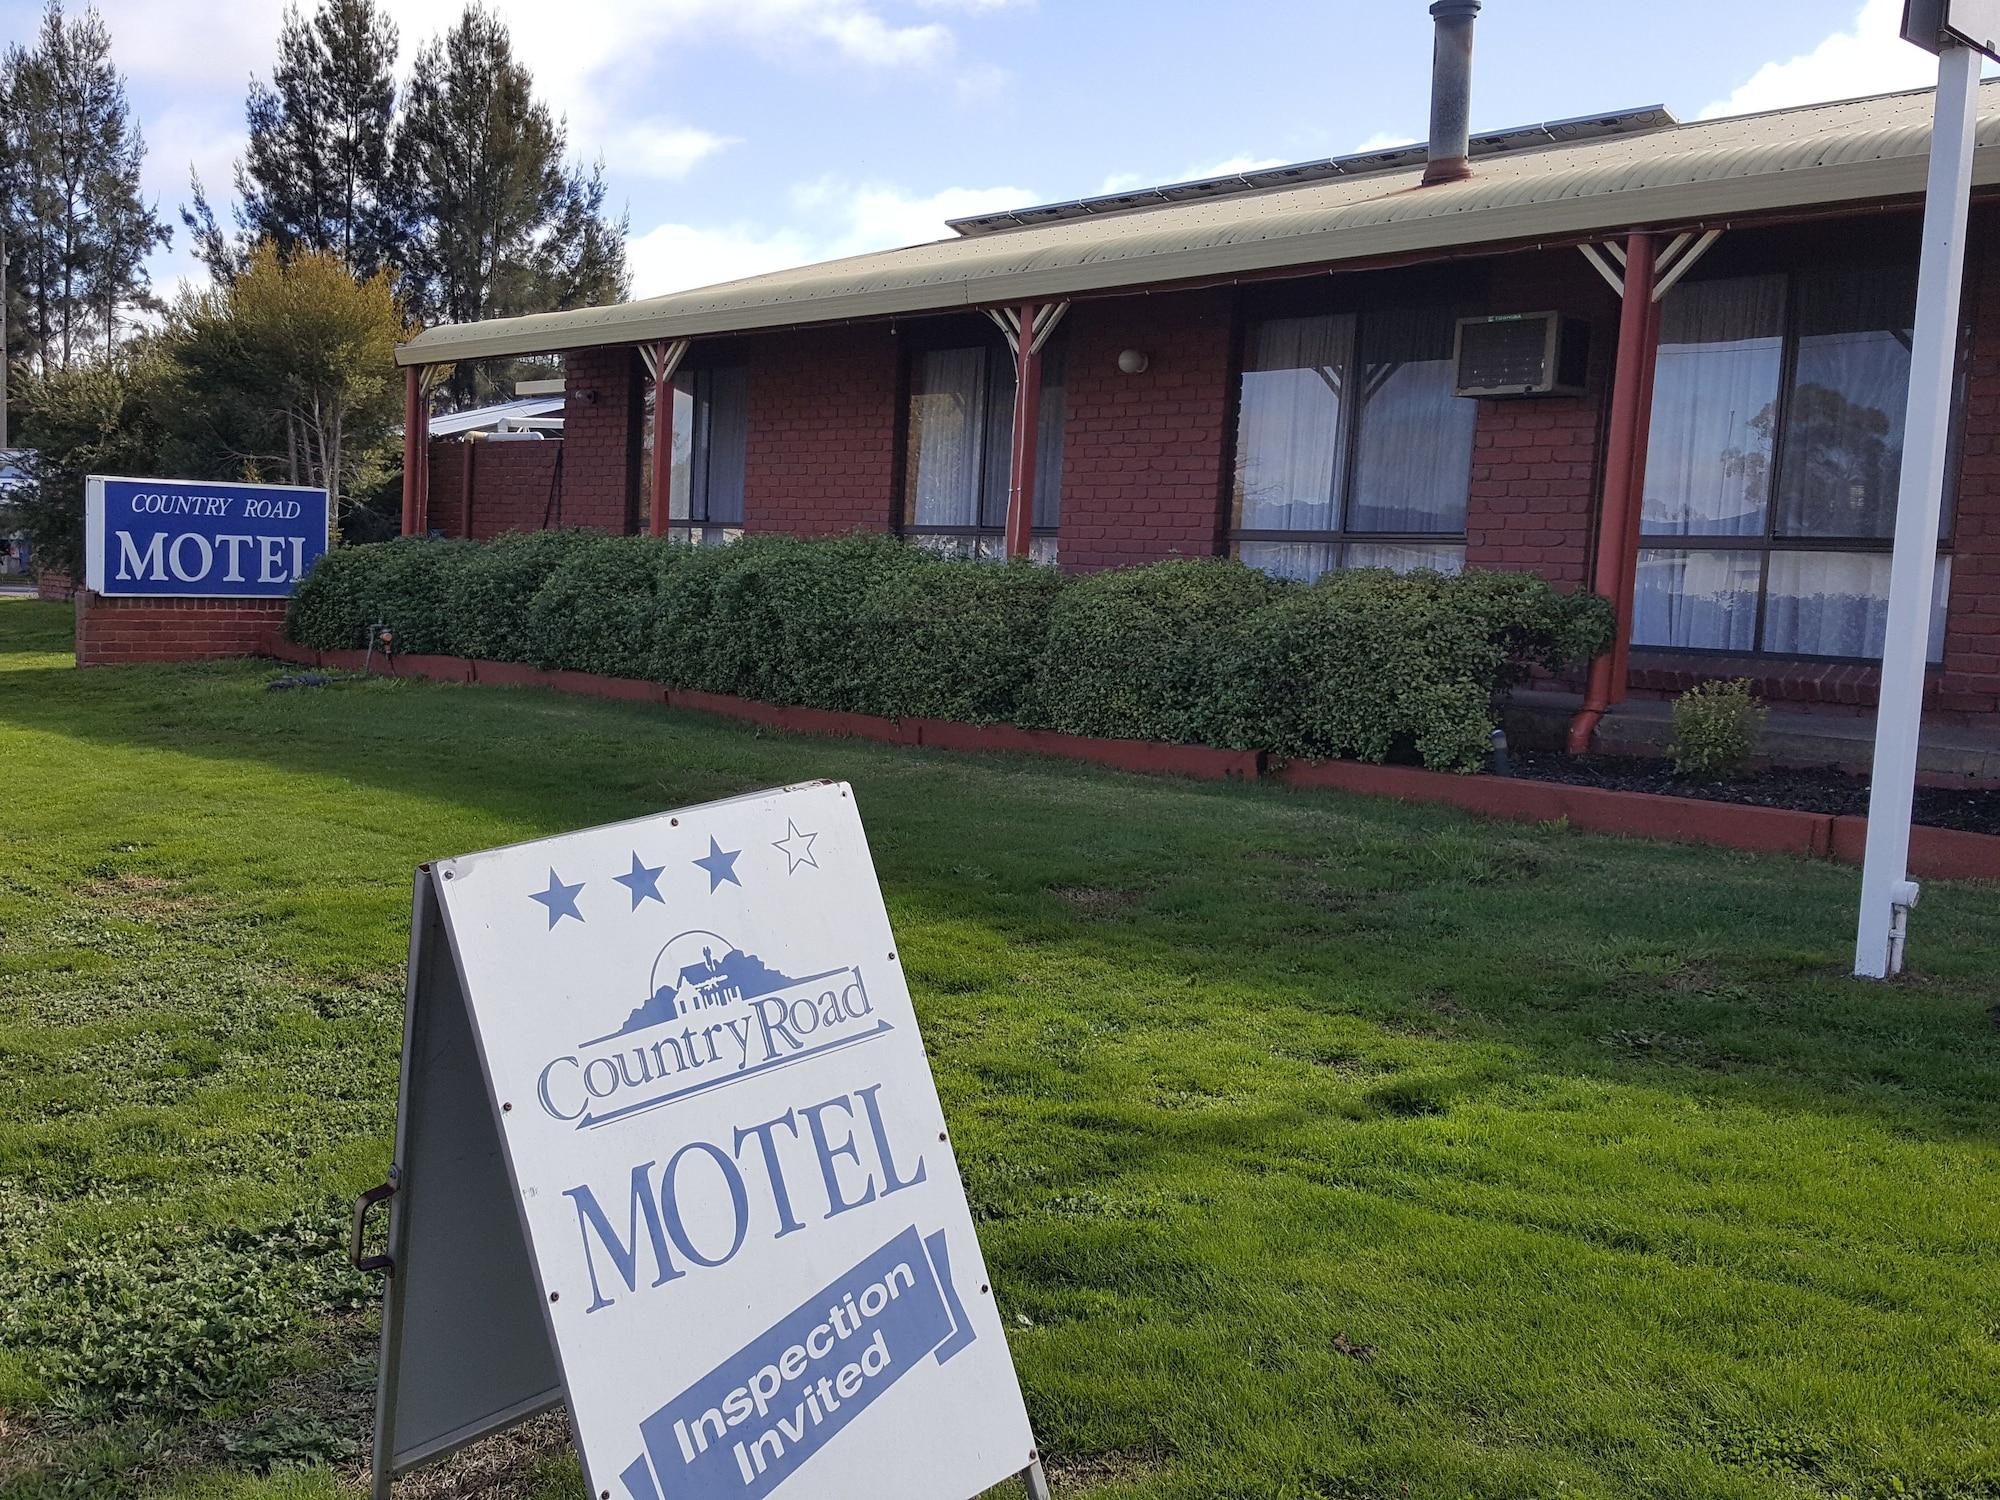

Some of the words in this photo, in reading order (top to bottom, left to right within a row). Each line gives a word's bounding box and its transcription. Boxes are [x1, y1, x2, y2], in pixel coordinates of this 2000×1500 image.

[131, 493, 232, 516] COUNTRY
[243, 499, 300, 519] ROAD
[562, 1083, 927, 1314] MOTEL
[673, 1262, 916, 1465] Inspection
[732, 1329, 892, 1486] Invited
